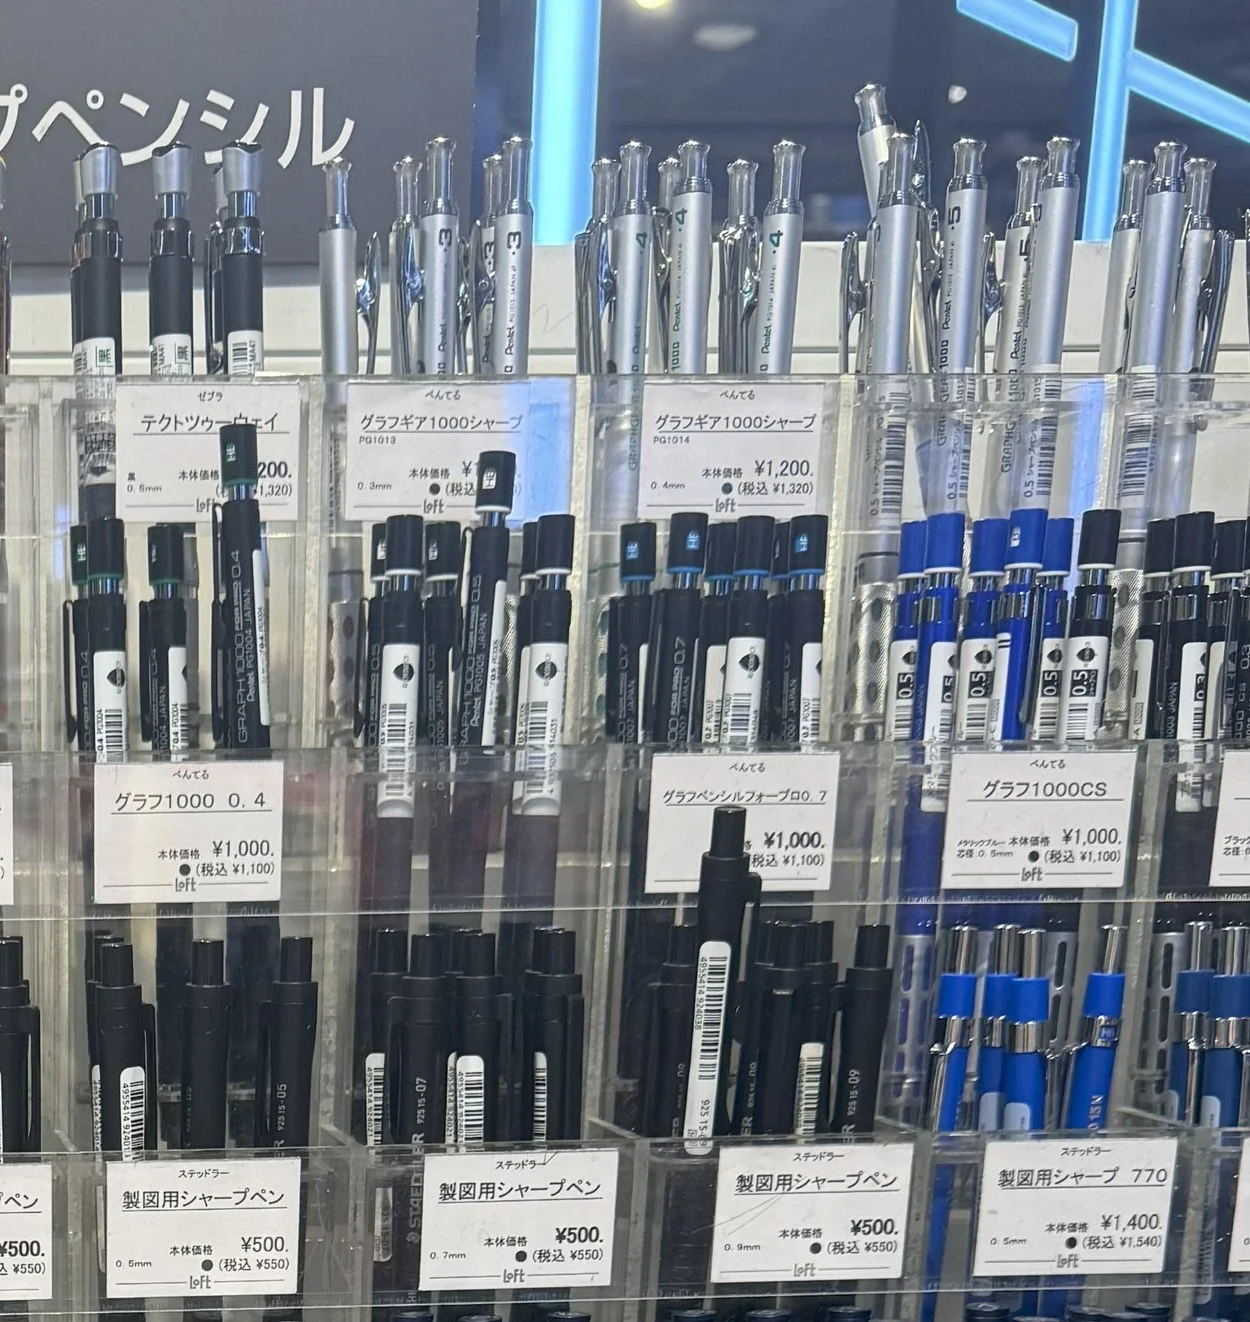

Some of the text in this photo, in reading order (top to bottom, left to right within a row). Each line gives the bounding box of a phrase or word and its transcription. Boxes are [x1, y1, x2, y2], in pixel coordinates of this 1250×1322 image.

[361, 414, 523, 430] グラフギア1000シャープ
[656, 413, 817, 430] グラフギア1000シャープ
[653, 436, 690, 444] PG1014
[773, 482, 813, 495] ¥1,320)
[983, 780, 1107, 799] グラフ1000CS
[115, 792, 214, 811] グラフ1000
[158, 849, 200, 860] 本体価格
[1080, 850, 1121, 863] ¥1,100)
[232, 862, 274, 875] ¥1,100)
[178, 1168, 229, 1179] ステッドラー
[998, 1166, 1168, 1187] 製図用シャープ 770
[735, 1170, 897, 1193] 製図用シャープペン
[439, 1178, 601, 1201] 製図用シャープペン
[122, 1187, 284, 1209] 製図用シャープペン
[1120, 1235, 1162, 1248] ¥1,540)
[169, 1245, 213, 1256] 本体価格
[256, 1258, 289, 1270] ¥550)
